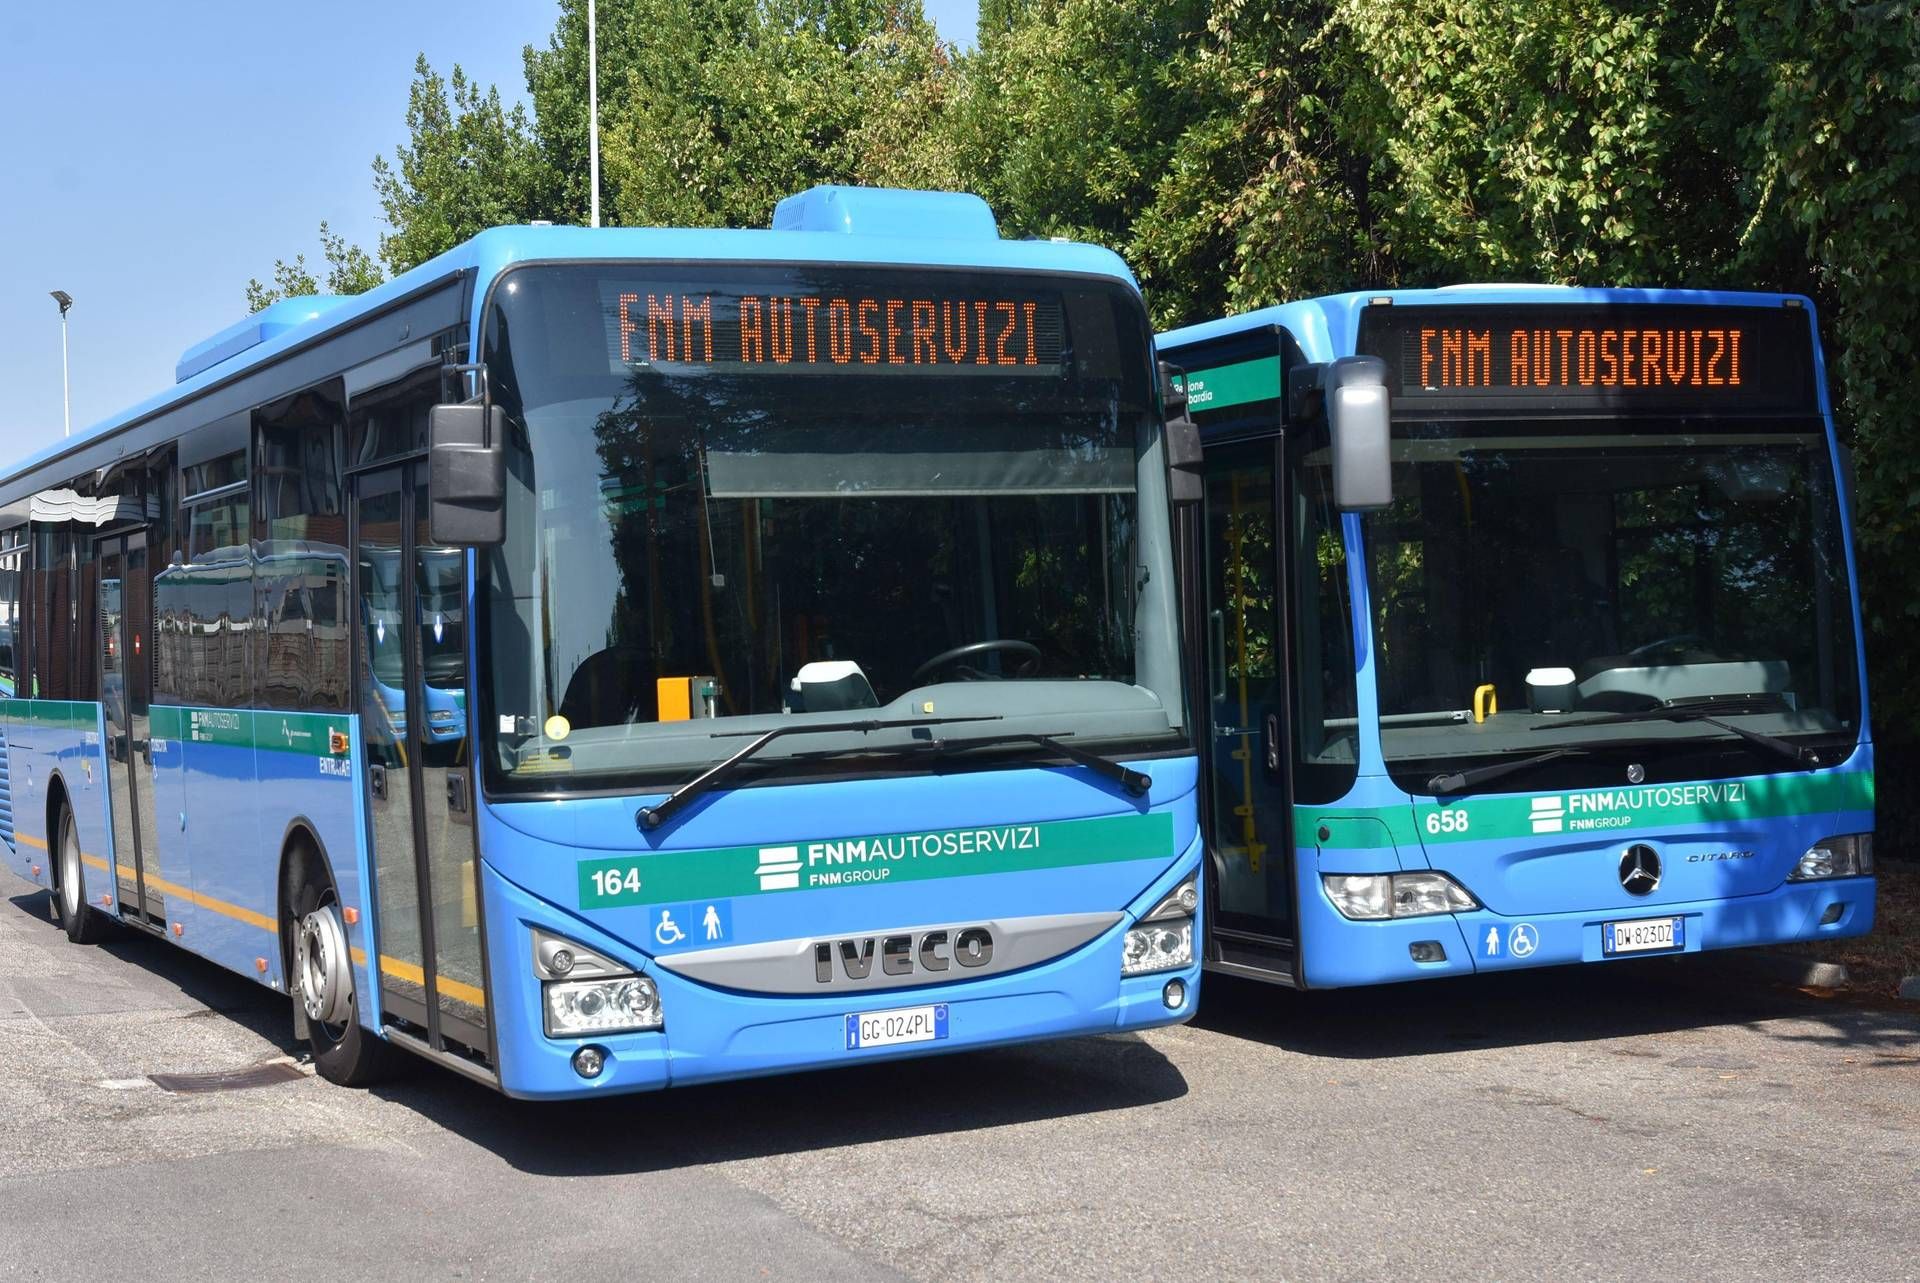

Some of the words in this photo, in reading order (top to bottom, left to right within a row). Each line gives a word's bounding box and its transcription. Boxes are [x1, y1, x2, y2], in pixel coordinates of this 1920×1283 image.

[619, 293, 713, 363] FNM
[739, 296, 1038, 366] AUTOSERVIZI
[1420, 328, 1490, 387] FNM
[1510, 329, 1742, 386] AUTOSERVIZI
[1174, 381, 1204, 393] Reione
[1426, 810, 1469, 834] 658
[1687, 850, 1754, 863] CITARO
[591, 868, 641, 895] 164
[814, 927, 995, 983] IVECO
